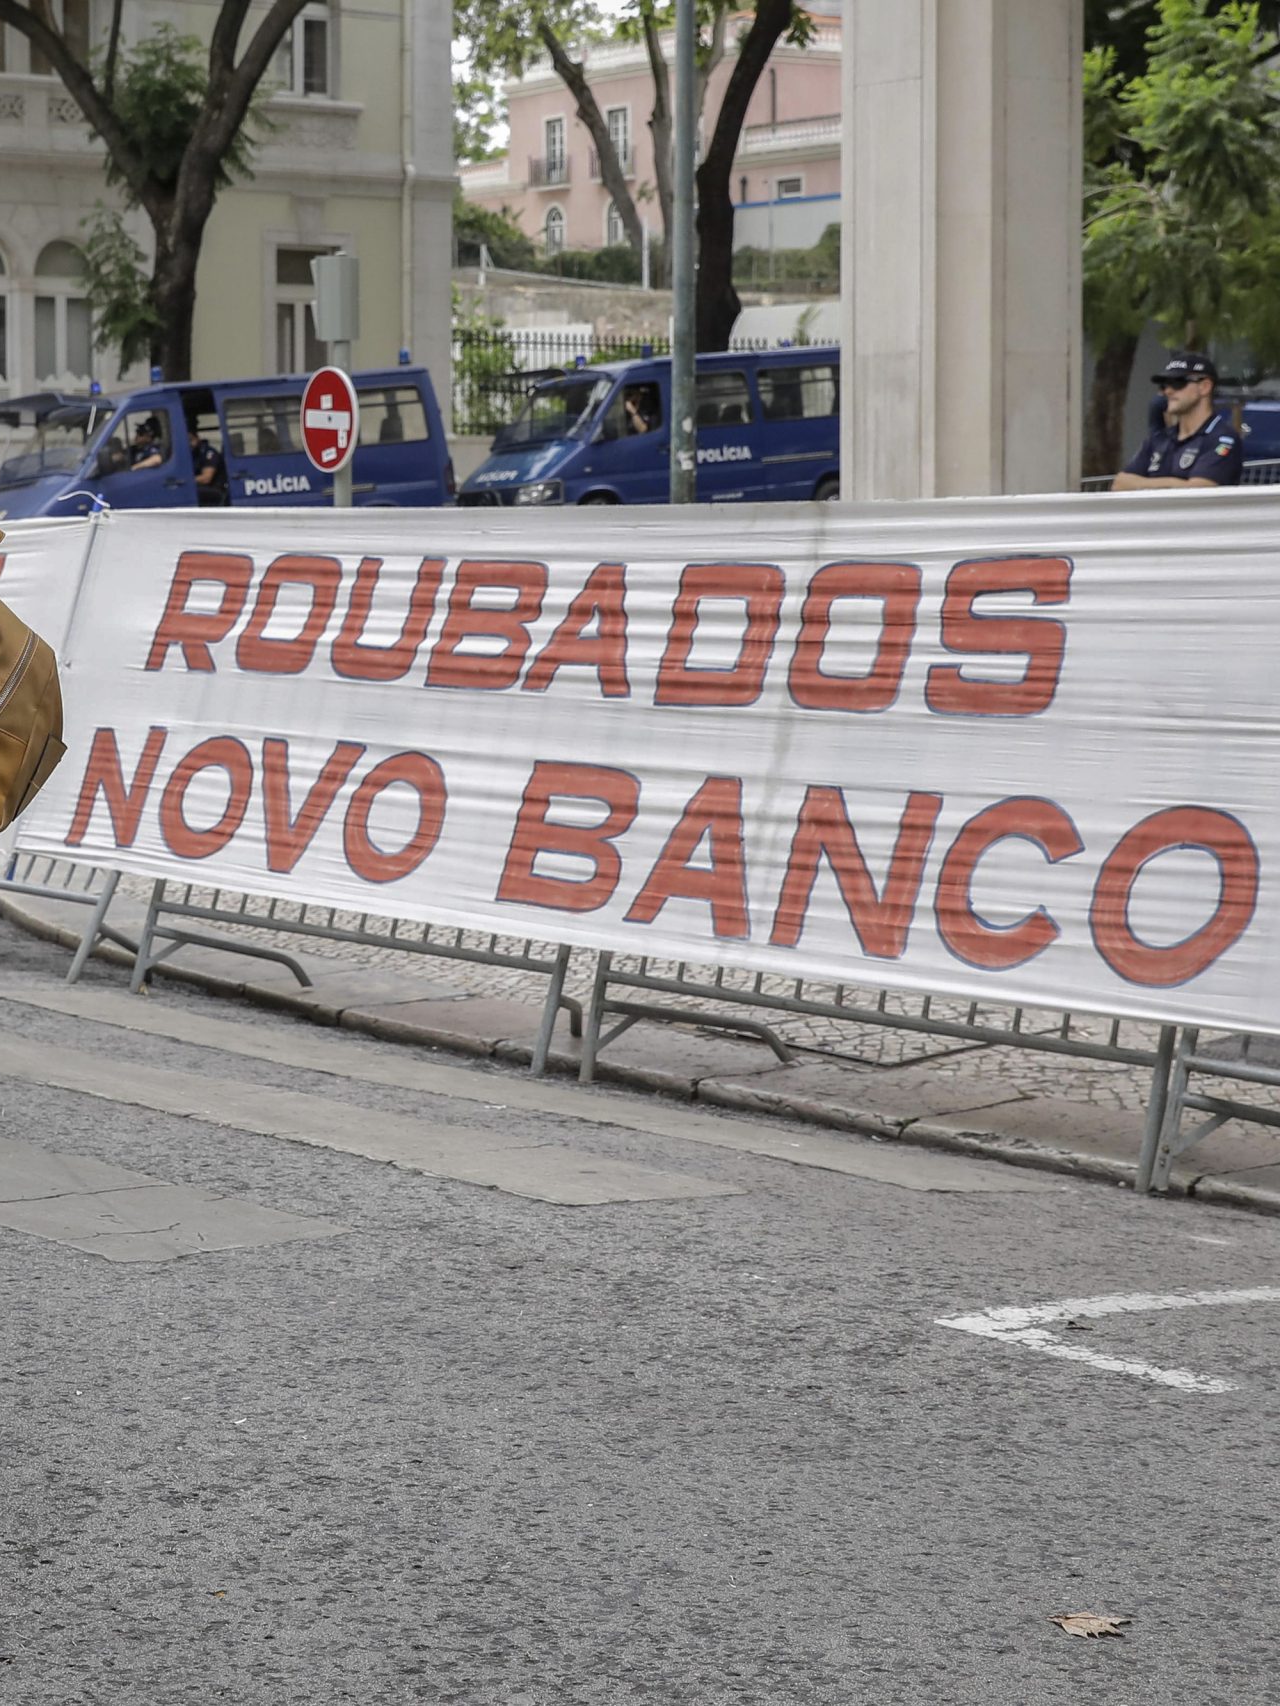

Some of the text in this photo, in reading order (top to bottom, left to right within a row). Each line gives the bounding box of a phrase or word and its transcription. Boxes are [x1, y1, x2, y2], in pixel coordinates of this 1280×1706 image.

[244, 473, 311, 496] POLÍCIA
[697, 443, 752, 464] POLÍCIA
[144, 551, 1074, 717] ROUBADOS
[63, 725, 1260, 988] NOVO BANCO
